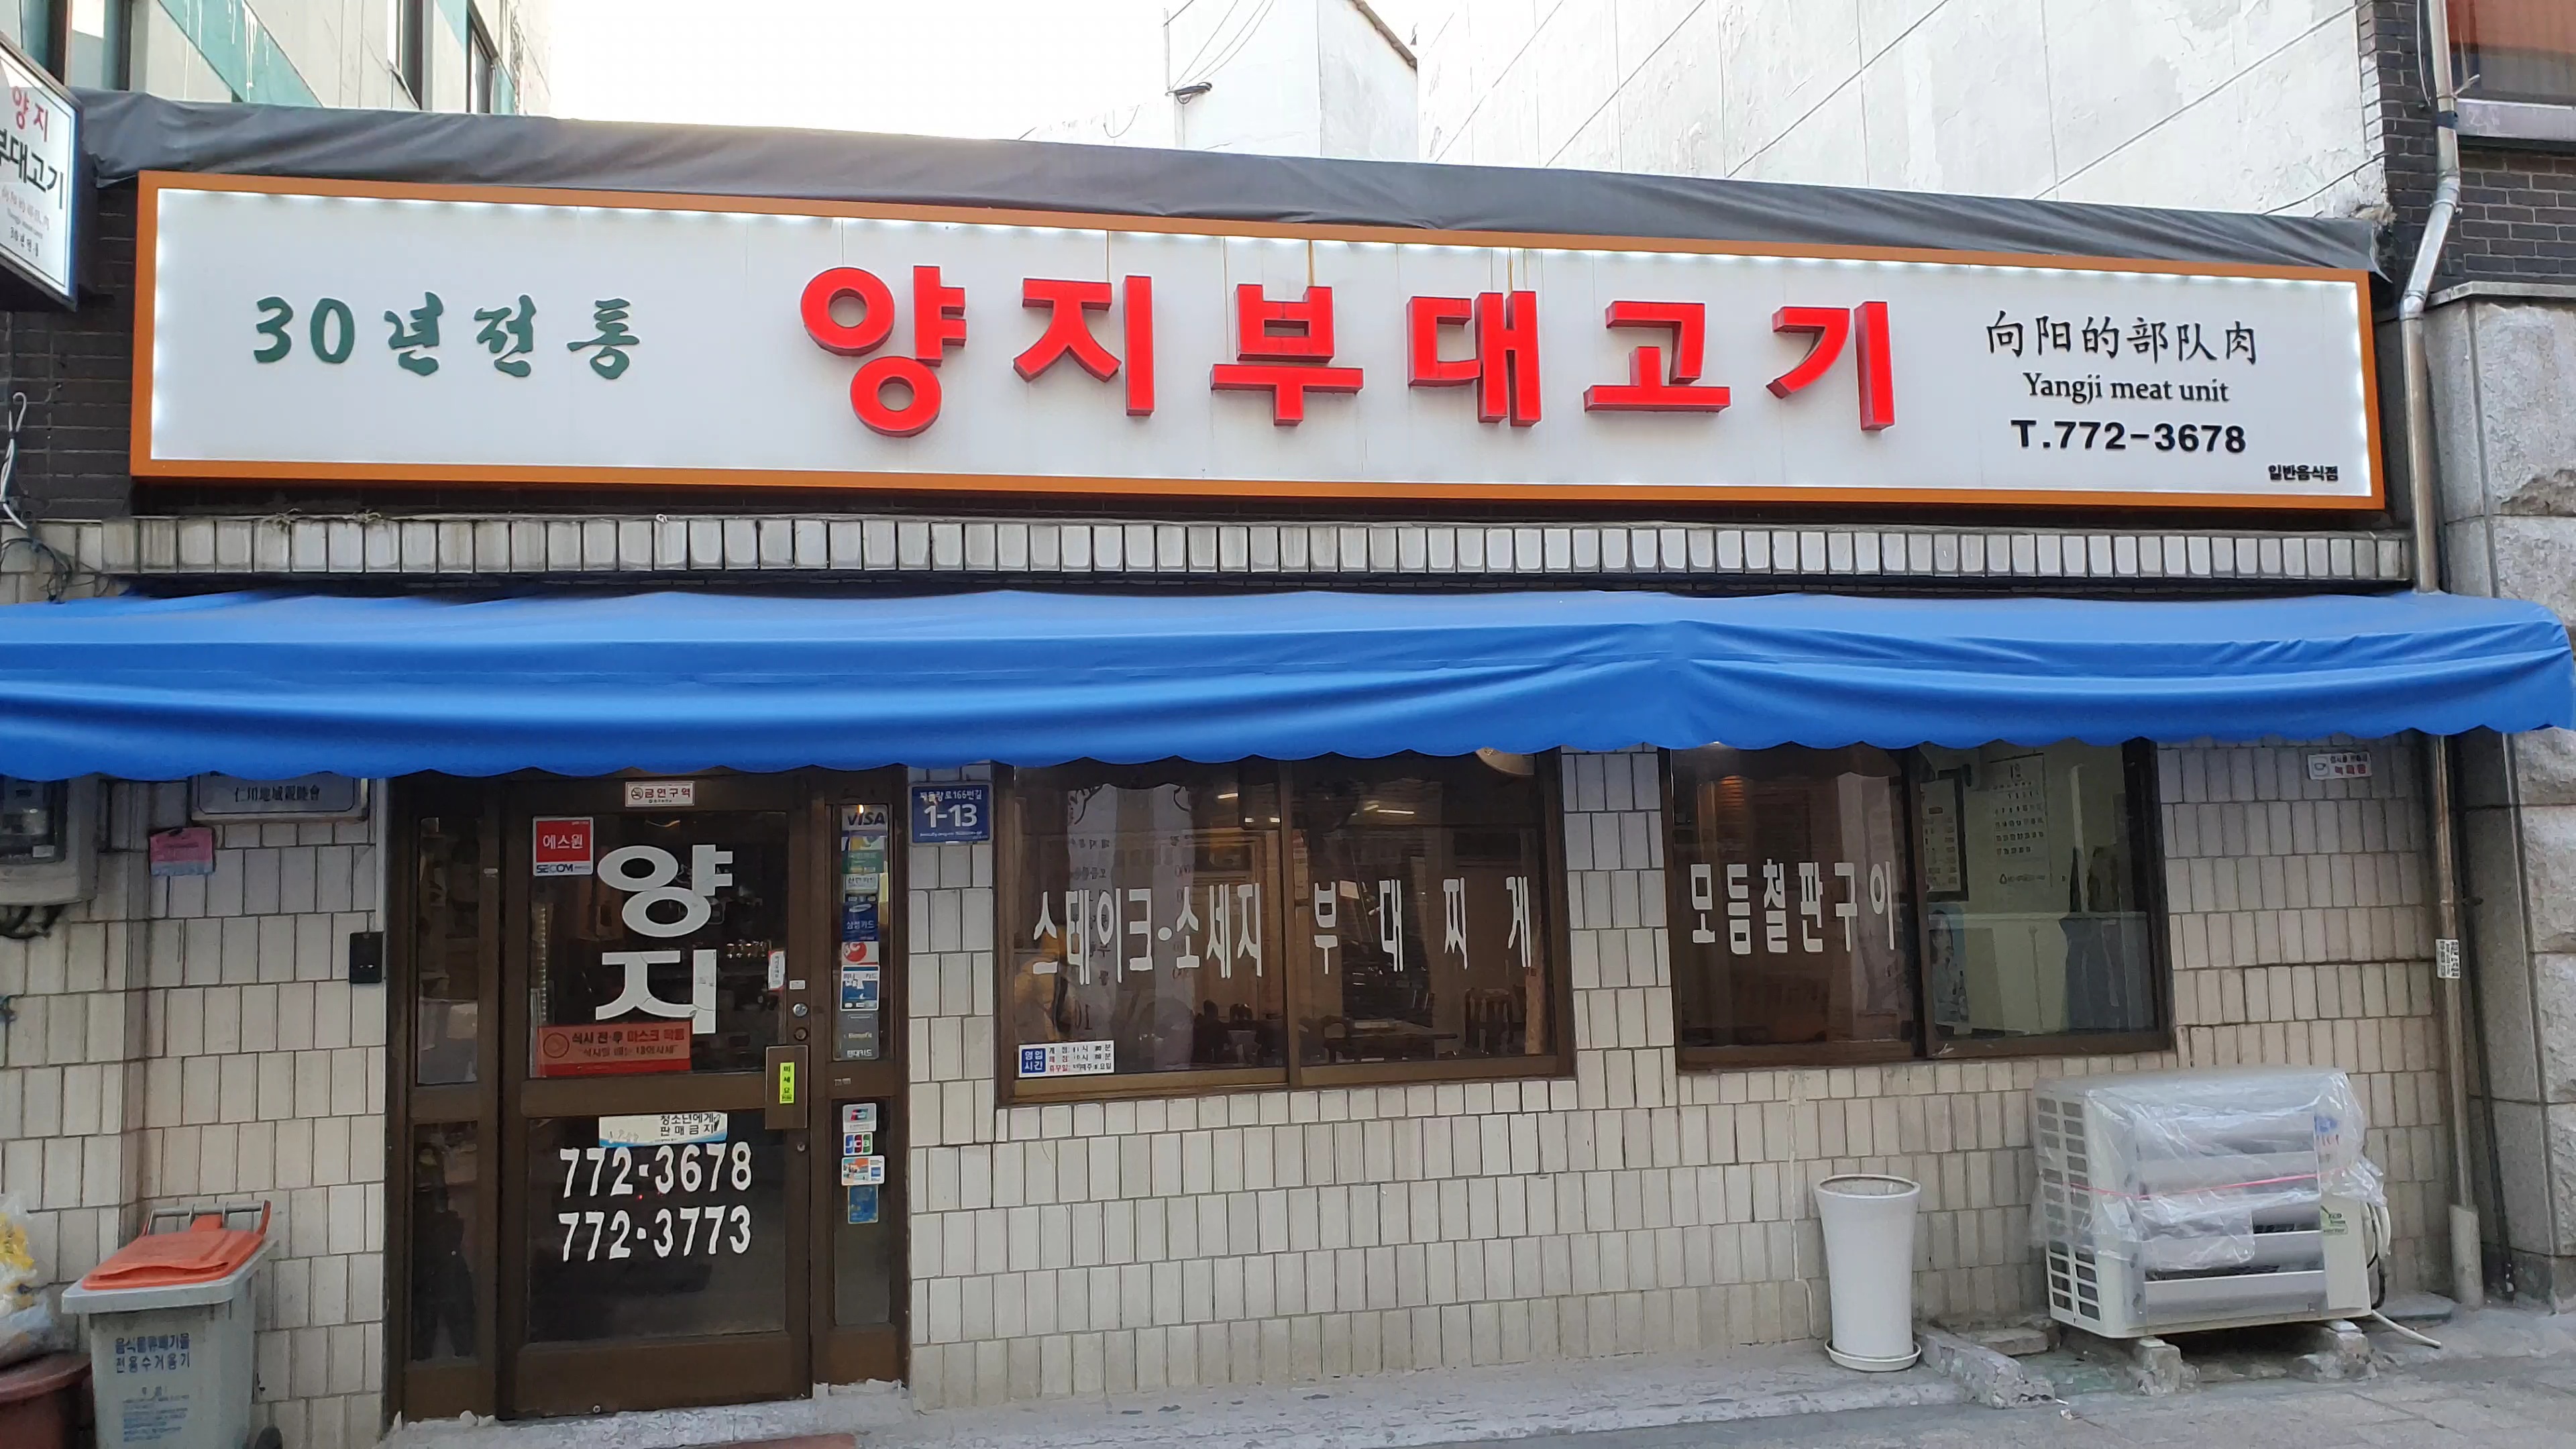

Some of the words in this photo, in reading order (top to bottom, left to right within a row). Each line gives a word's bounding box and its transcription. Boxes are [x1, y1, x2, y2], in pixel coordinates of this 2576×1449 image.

[12, 85, 49, 143] 양지
[1985, 310, 2258, 366] 向阳的部队肉
[800, 265, 1895, 438] 양지부대고기
[2022, 372, 2103, 405] Yangji
[2110, 377, 2173, 401] meat
[2178, 376, 2231, 403] unit
[2010, 419, 2247, 454] T.772-3678
[2267, 464, 2339, 482] 일반음식점
[847, 811, 885, 826] VISA
[924, 803, 978, 828] 1-13
[543, 833, 584, 850] 에스원
[536, 863, 574, 874] SECOM
[1690, 858, 1896, 955] 모듬철판구이
[596, 843, 733, 1034] 양지
[1024, 1051, 1044, 1061] 영업
[1024, 1061, 1044, 1071] 시간
[660, 1112, 714, 1125] 청소년에게
[116, 1352, 191, 1374] 전용수거용기
